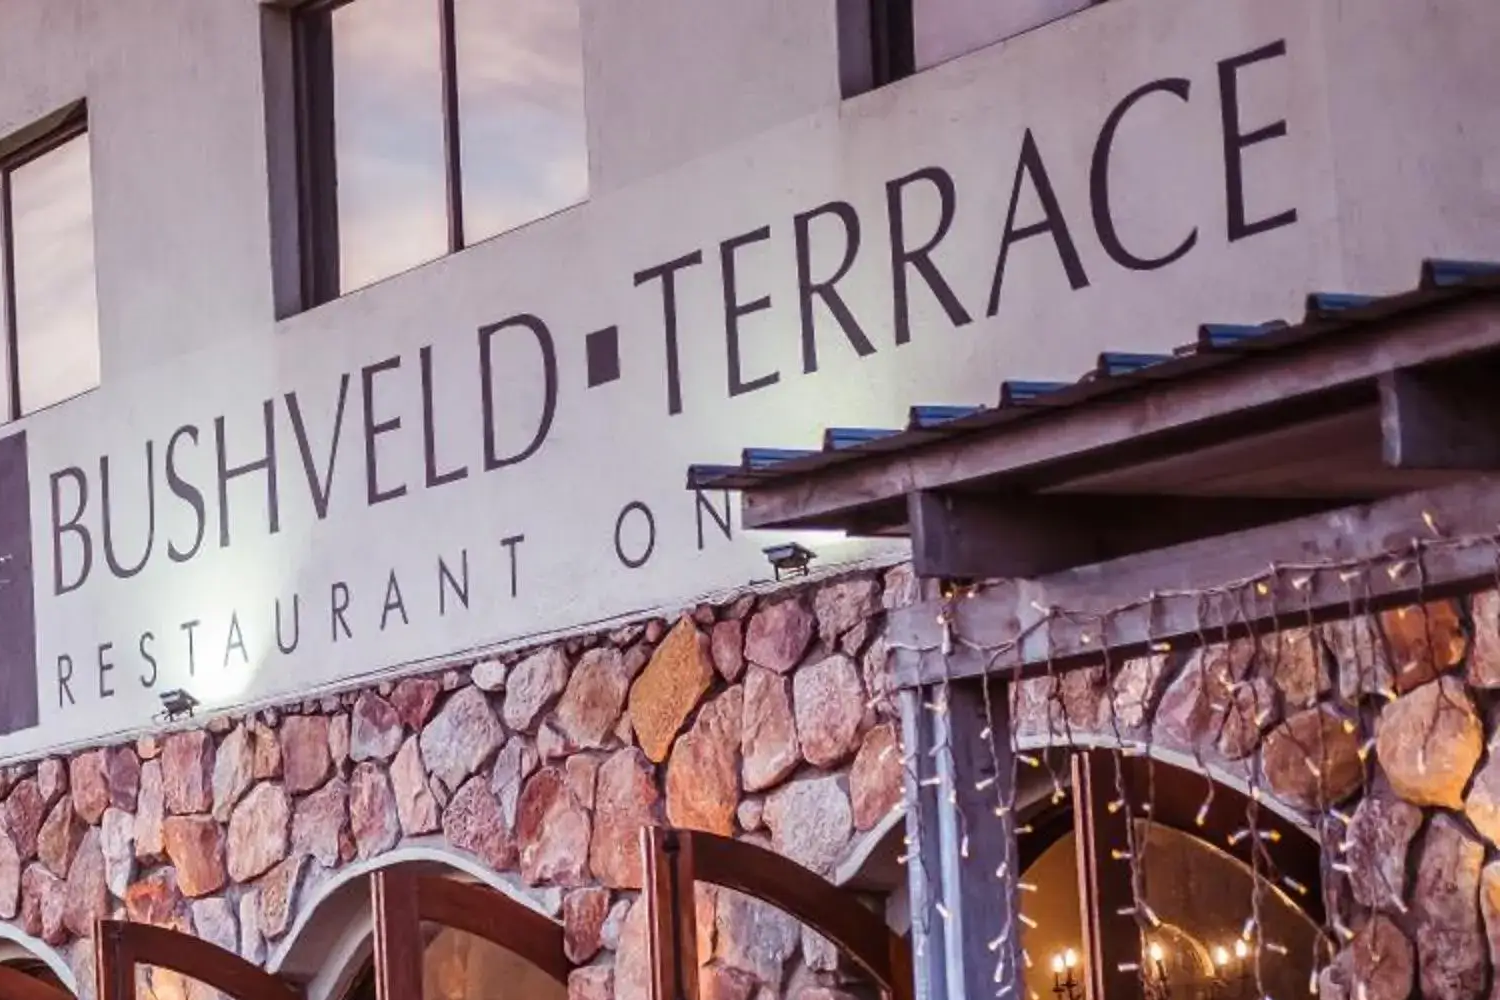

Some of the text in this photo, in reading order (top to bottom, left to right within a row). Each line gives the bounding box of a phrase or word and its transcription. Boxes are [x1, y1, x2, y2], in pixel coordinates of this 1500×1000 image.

[50, 39, 1298, 596] BUSHVELD TERRACE
[57, 488, 731, 707] RESTAURANT ON
